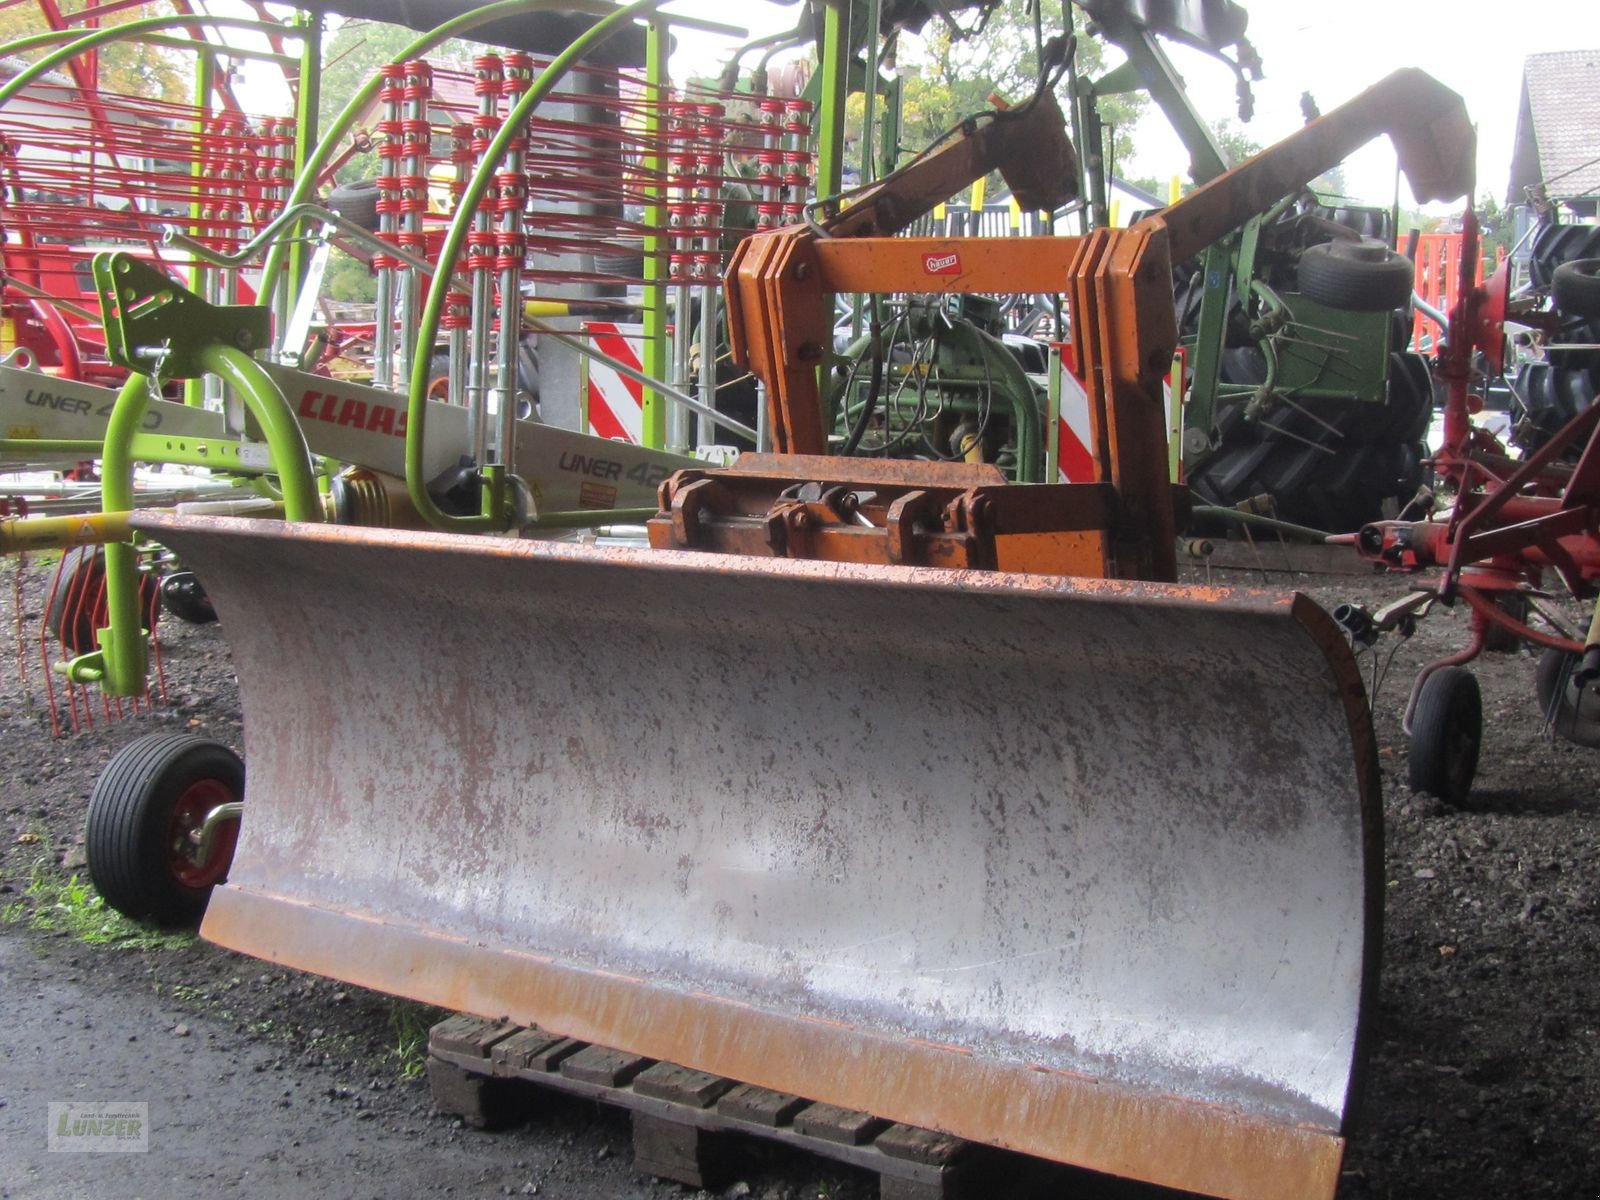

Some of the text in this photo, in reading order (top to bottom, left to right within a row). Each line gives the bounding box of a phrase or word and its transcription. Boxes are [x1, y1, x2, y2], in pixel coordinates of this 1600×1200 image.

[24, 389, 163, 430] LINER 40
[559, 451, 668, 489] LINER 42
